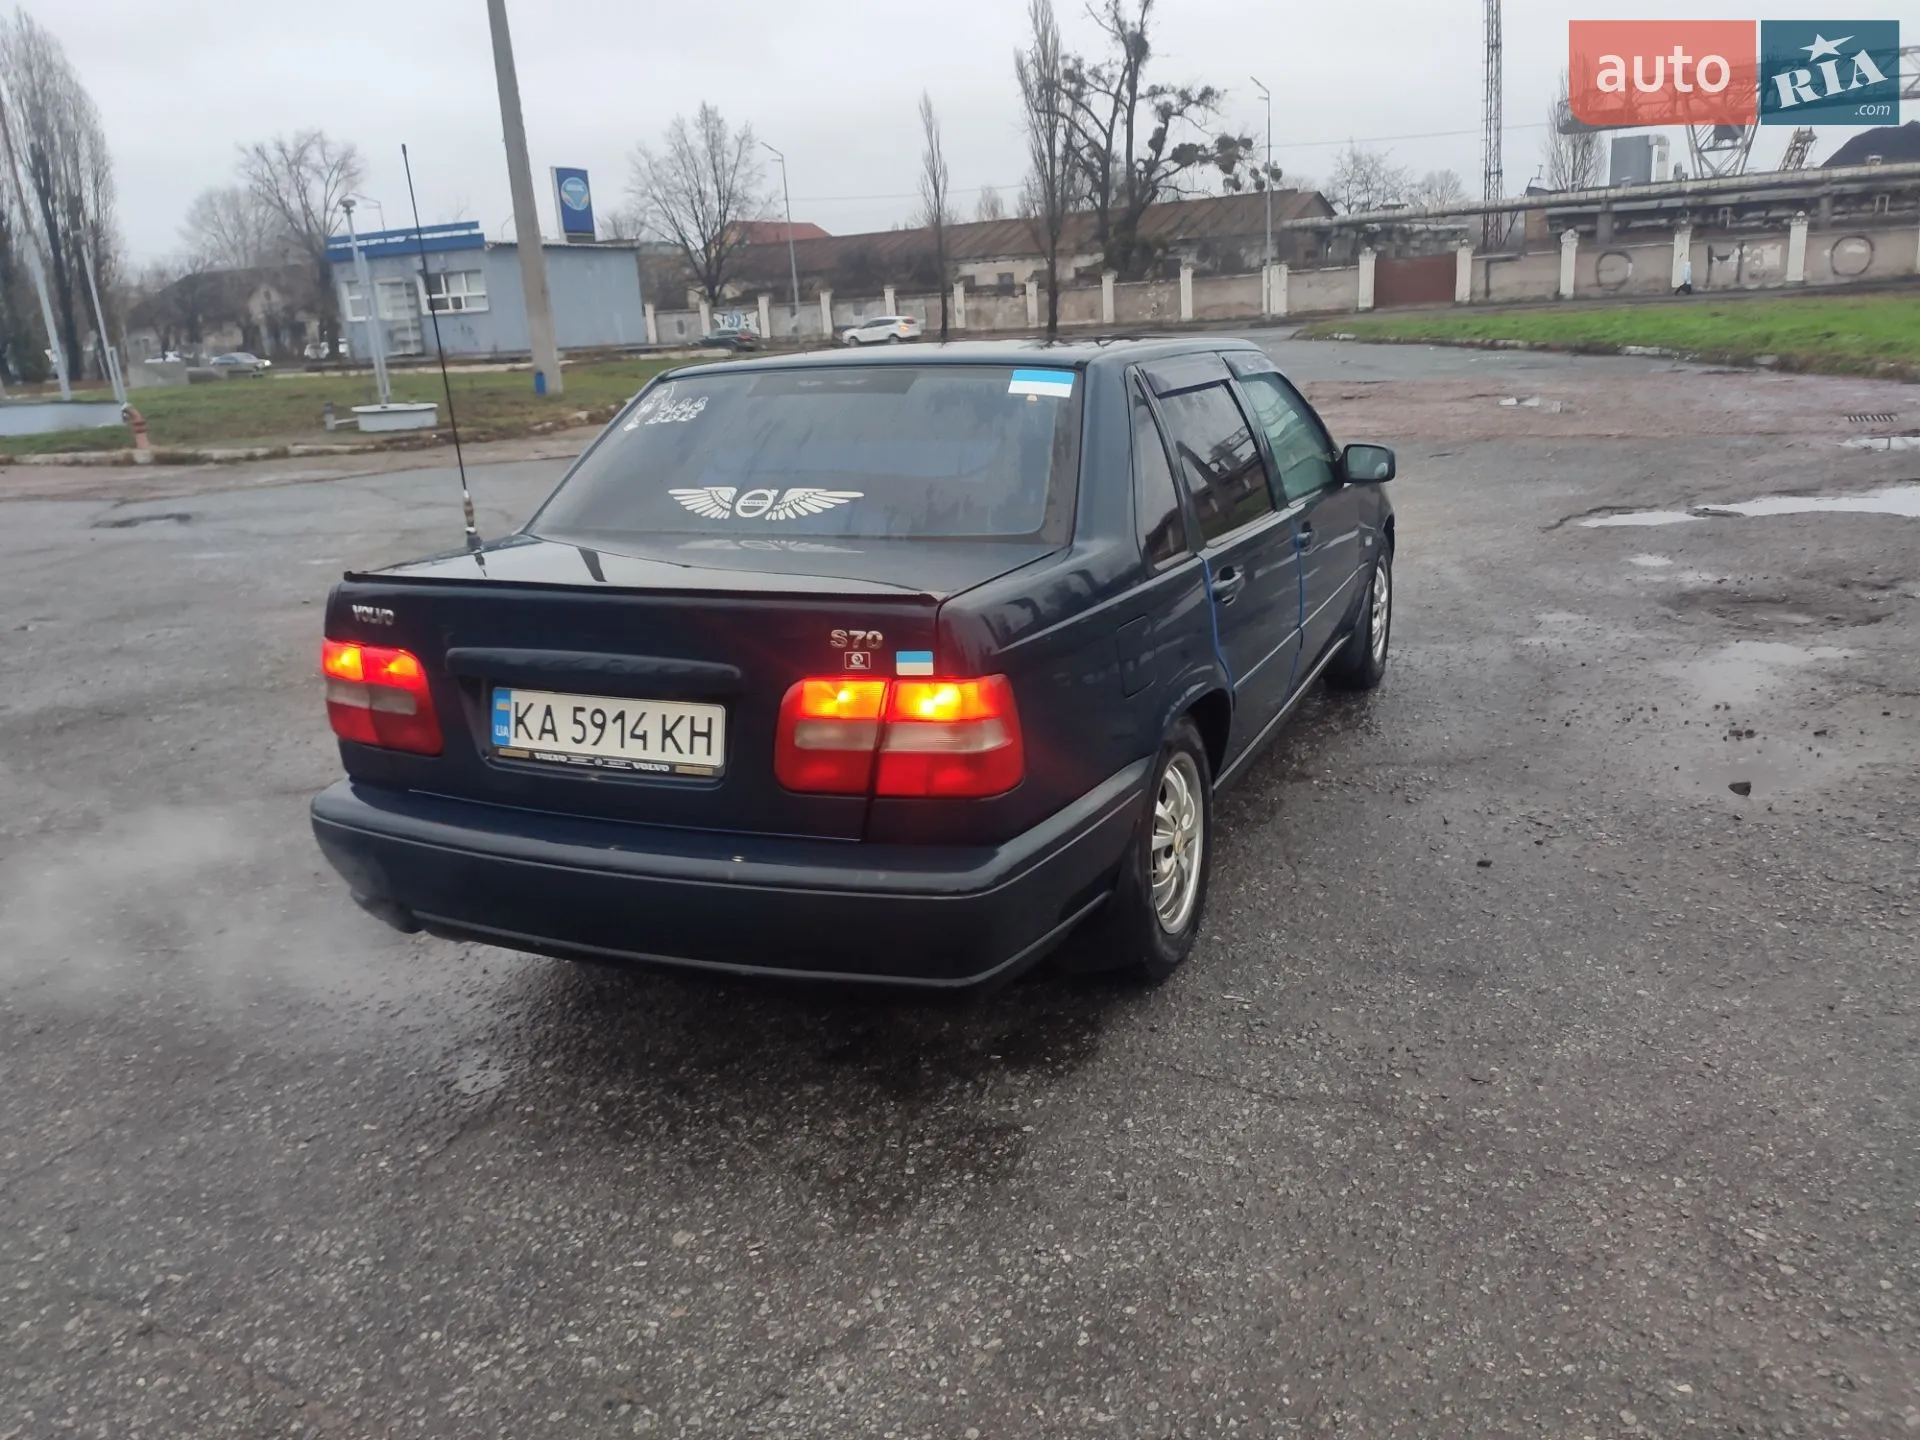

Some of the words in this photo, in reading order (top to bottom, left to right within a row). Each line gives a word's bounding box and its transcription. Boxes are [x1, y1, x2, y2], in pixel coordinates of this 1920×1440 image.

[352, 604, 394, 626] VOLVO
[830, 629, 883, 649] S70
[495, 723, 510, 738] UA
[514, 701, 558, 742] KA
[571, 706, 648, 751] 5914
[661, 713, 713, 756] KH
[534, 752, 568, 763] VOLVO
[632, 761, 670, 772] VOLVO
